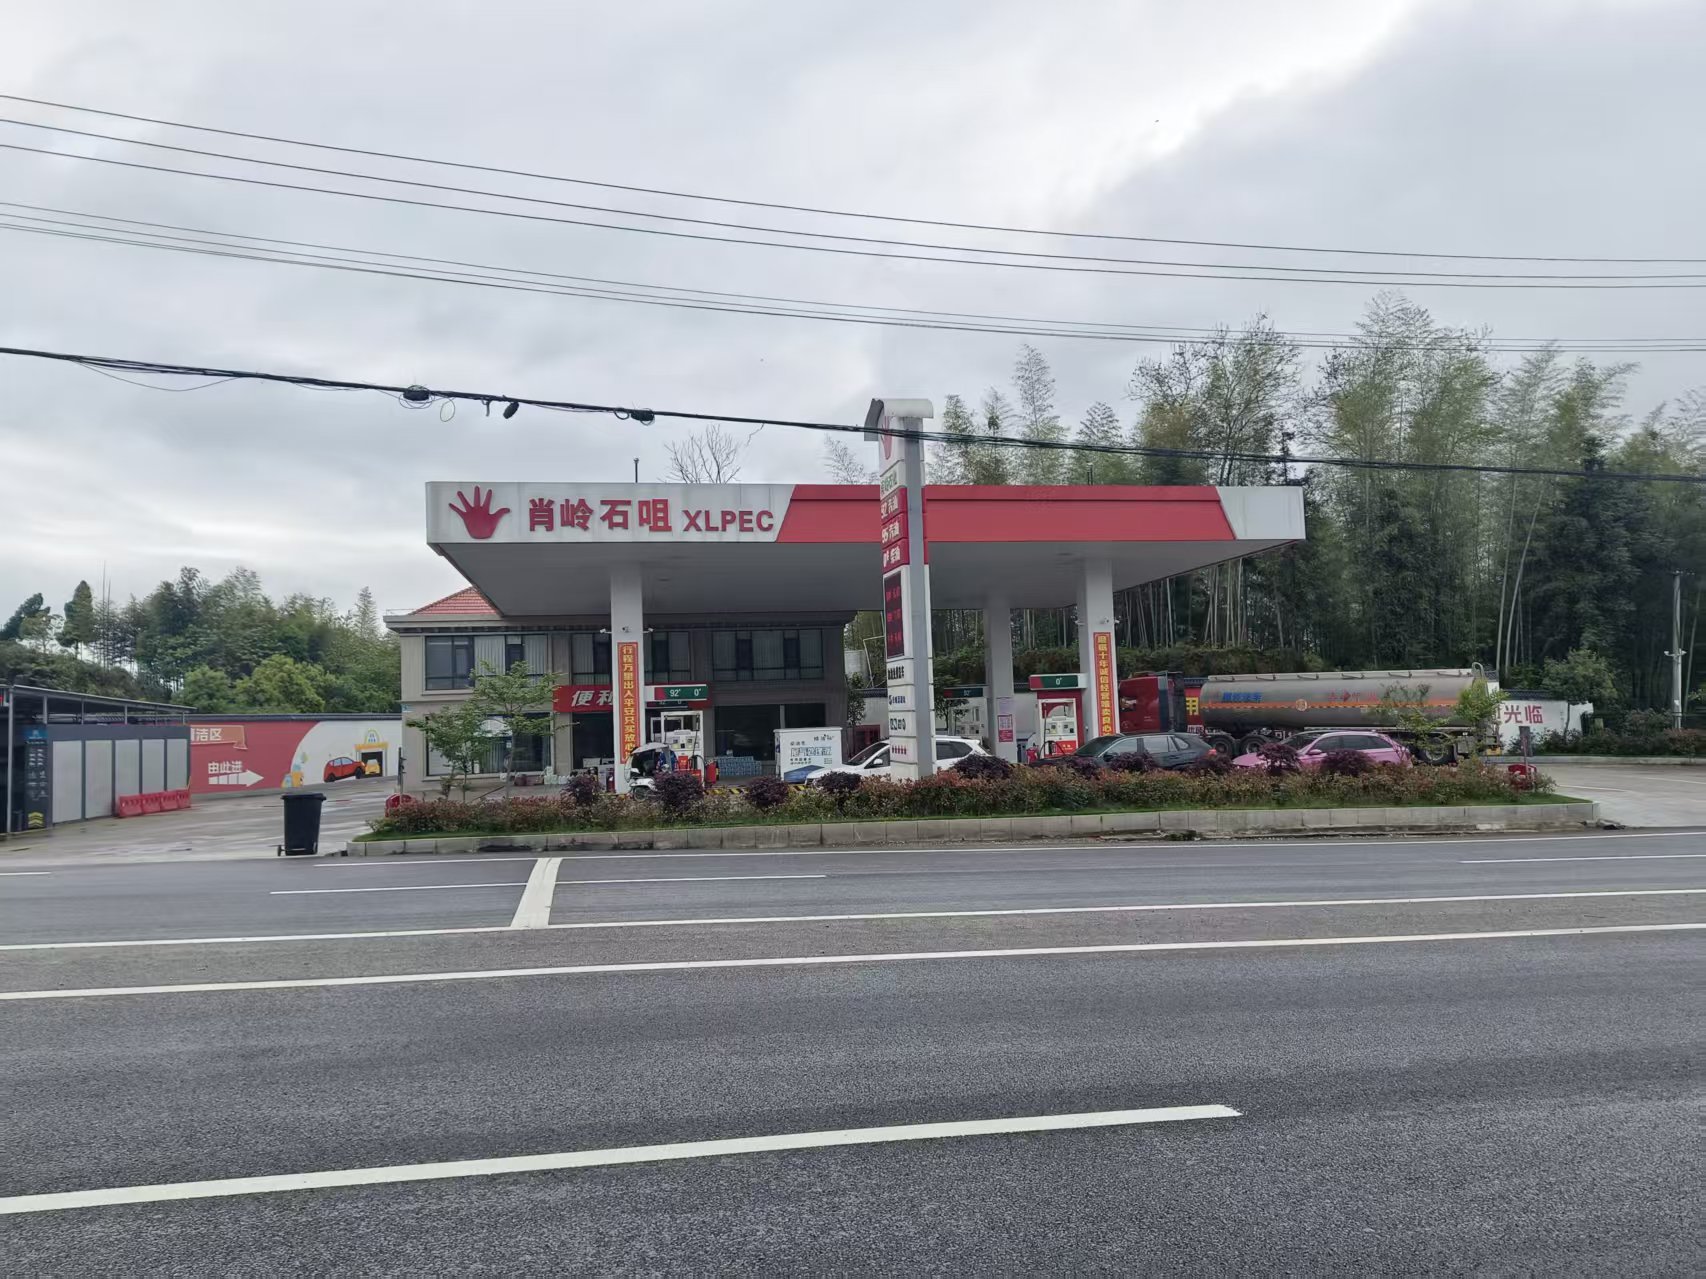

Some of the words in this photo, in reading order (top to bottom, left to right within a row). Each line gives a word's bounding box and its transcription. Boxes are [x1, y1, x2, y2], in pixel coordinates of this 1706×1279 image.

[529, 498, 672, 533] 肖岭石咀
[683, 510, 774, 532] XLPEC
[1496, 703, 1543, 724] 光临
